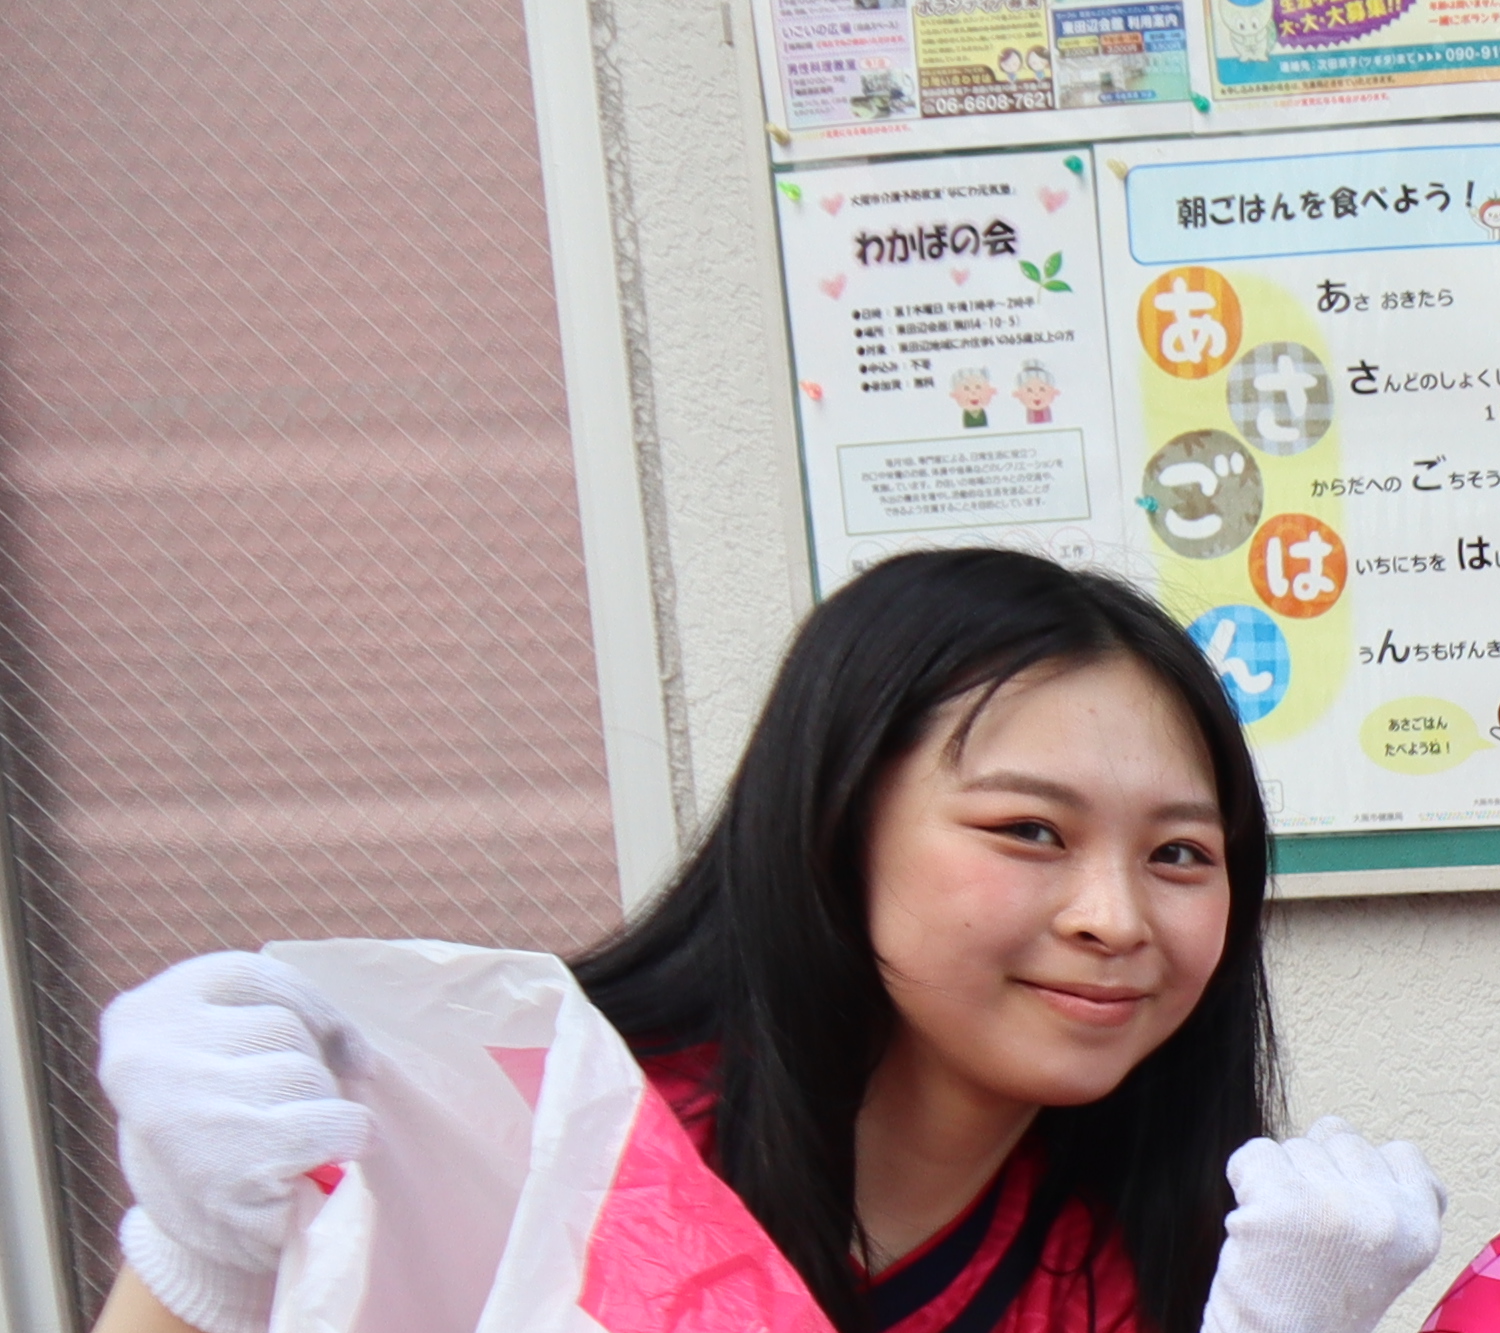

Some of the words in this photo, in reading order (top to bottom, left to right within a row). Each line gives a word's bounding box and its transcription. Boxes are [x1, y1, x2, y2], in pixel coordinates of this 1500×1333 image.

[1176, 180, 1476, 229] 朝ごはんを食べよう！
[855, 219, 1017, 266] わかばの会
[1154, 277, 1227, 363] あ
[1317, 280, 1371, 314] あさ
[1382, 288, 1454, 310] おきたら
[1254, 354, 1318, 442] さ
[1158, 451, 1245, 540] ご
[1311, 474, 1401, 498] からだへの
[1265, 530, 1335, 601] は
[1355, 553, 1446, 575] いちにちを
[1205, 618, 1274, 694] ん
[1388, 717, 1448, 732] あさごはん
